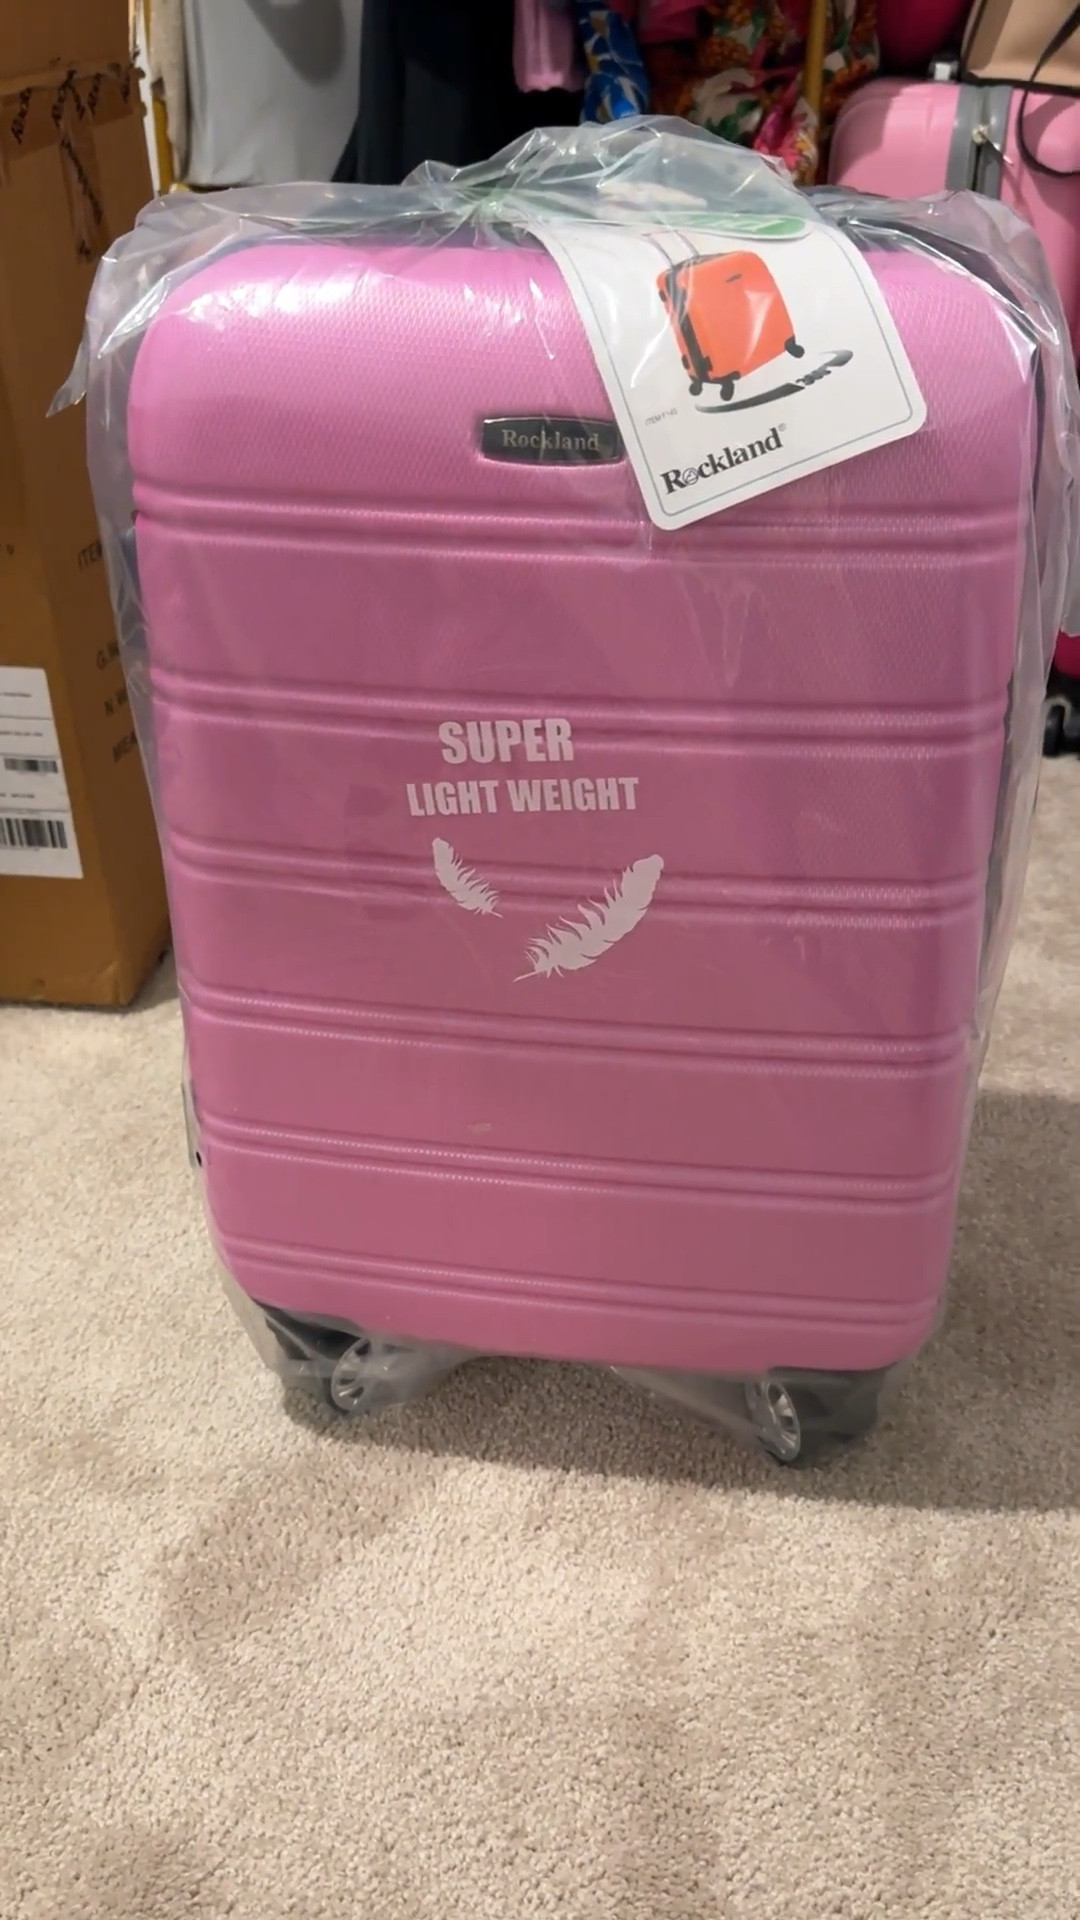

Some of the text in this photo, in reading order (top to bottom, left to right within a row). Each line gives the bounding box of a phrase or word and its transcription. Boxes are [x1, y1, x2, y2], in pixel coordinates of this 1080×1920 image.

[501, 429, 601, 452] Rockland
[660, 427, 783, 495] Rockland
[438, 718, 574, 764] SUPER
[406, 777, 639, 816] LIGHT WEIGHT
